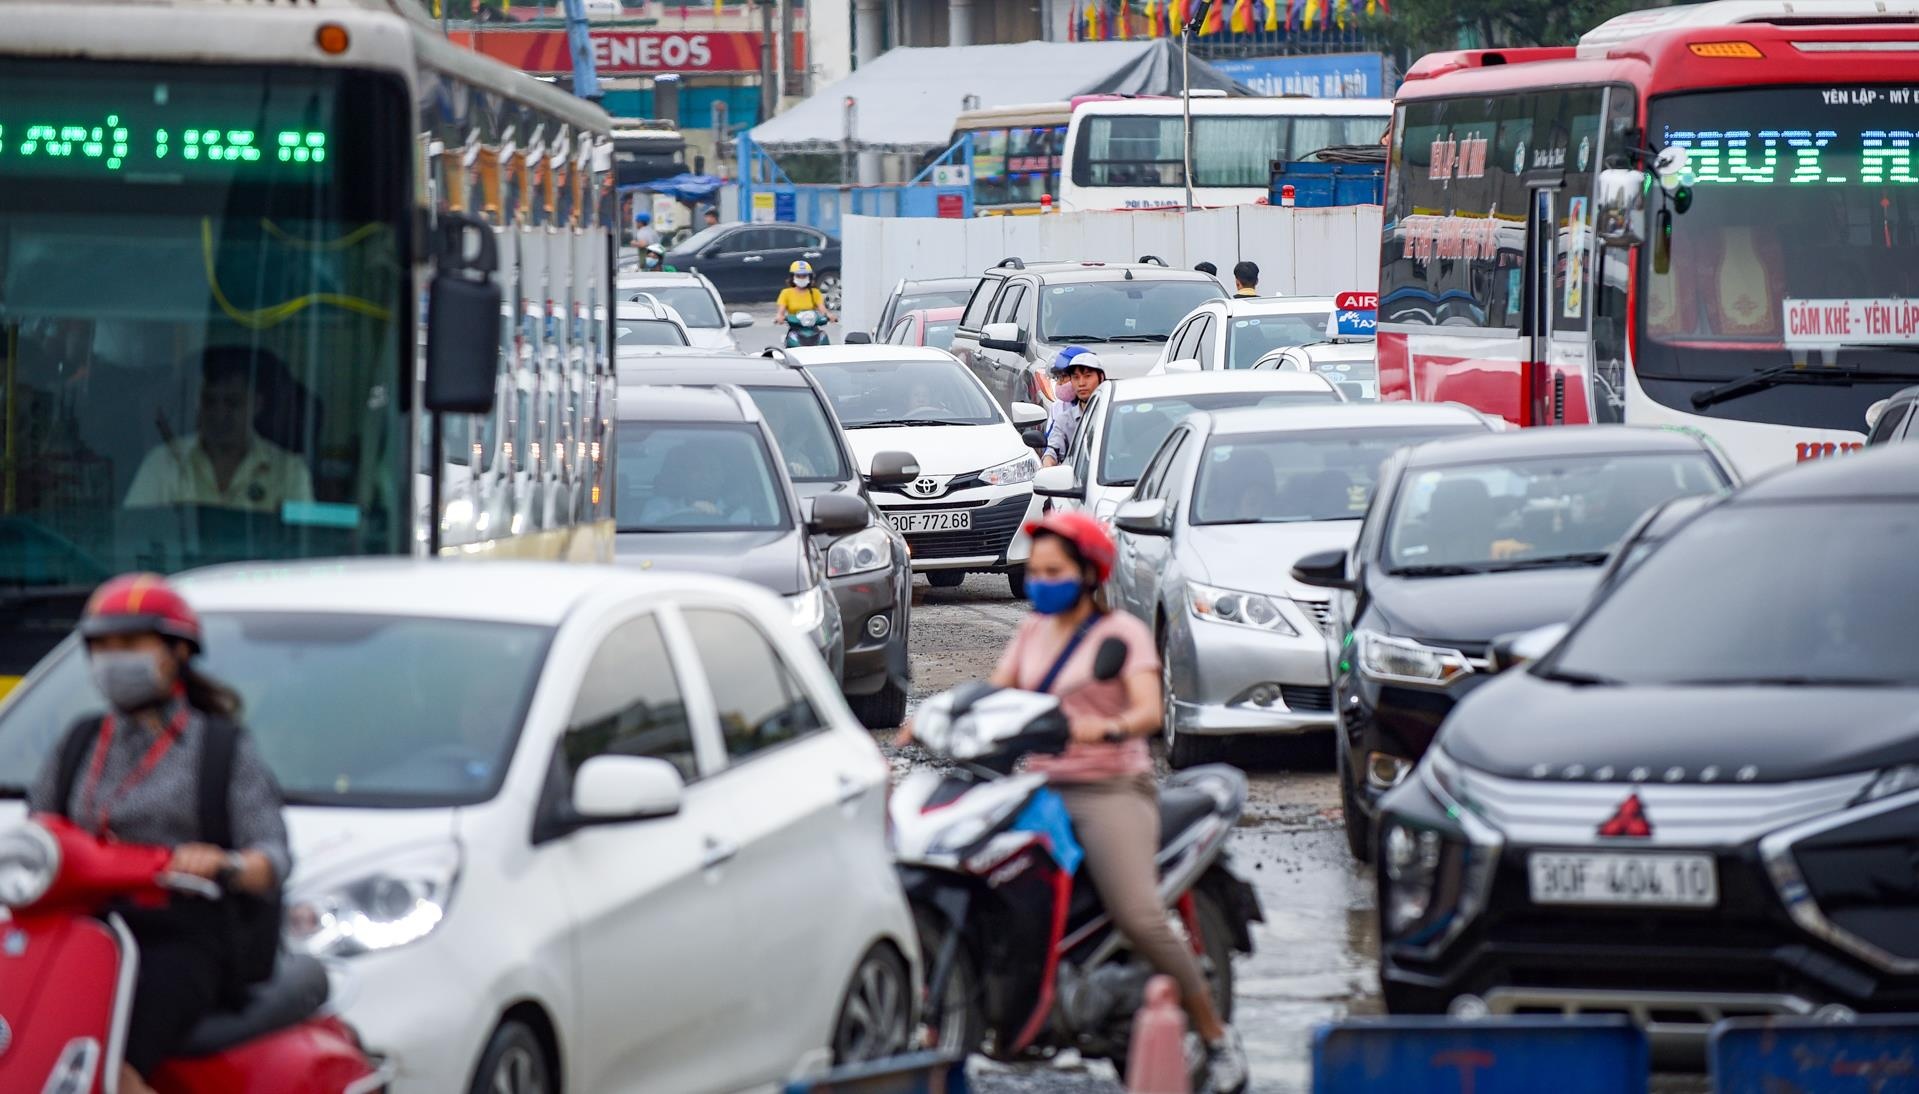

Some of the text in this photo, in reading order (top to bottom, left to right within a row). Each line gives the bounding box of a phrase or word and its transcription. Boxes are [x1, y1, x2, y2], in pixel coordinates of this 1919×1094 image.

[590, 36, 711, 66] ENEOS
[1285, 70, 1320, 98] HÀNG
[1324, 70, 1343, 97] HÀ
[1822, 88, 1849, 105] YÊN
[1851, 88, 1877, 106] LẬP
[1889, 88, 1910, 104] MỸ
[1344, 295, 1378, 307] AIR
[1351, 319, 1376, 328] TAX
[1824, 300, 1851, 335] KHÊ
[1864, 300, 1891, 335] YÊN
[1895, 300, 1919, 339] LẬP
[890, 512, 969, 531] 30F-772.68
[1537, 855, 1711, 897] 30F-404.10
